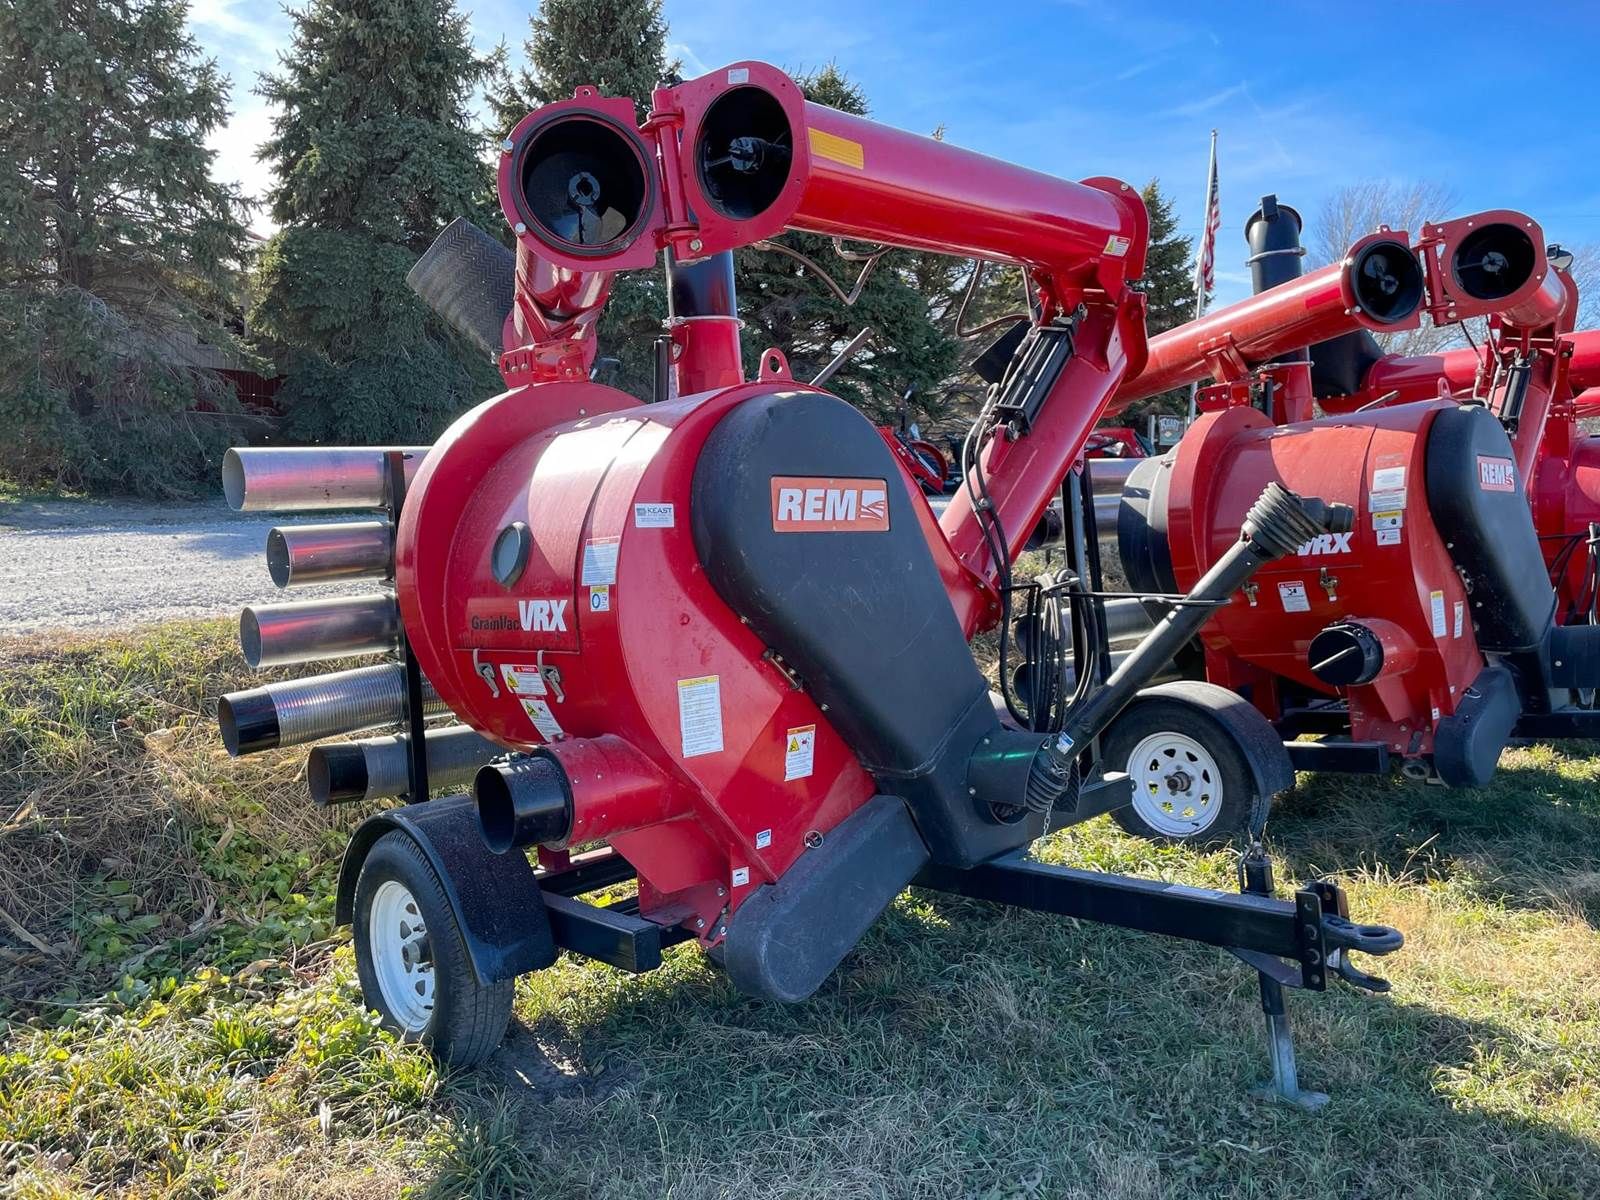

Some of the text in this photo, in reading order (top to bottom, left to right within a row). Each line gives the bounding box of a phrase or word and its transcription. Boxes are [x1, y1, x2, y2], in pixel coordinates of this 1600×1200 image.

[1480, 462, 1506, 484] REM
[778, 488, 857, 520] REM
[519, 600, 568, 631] VRX
